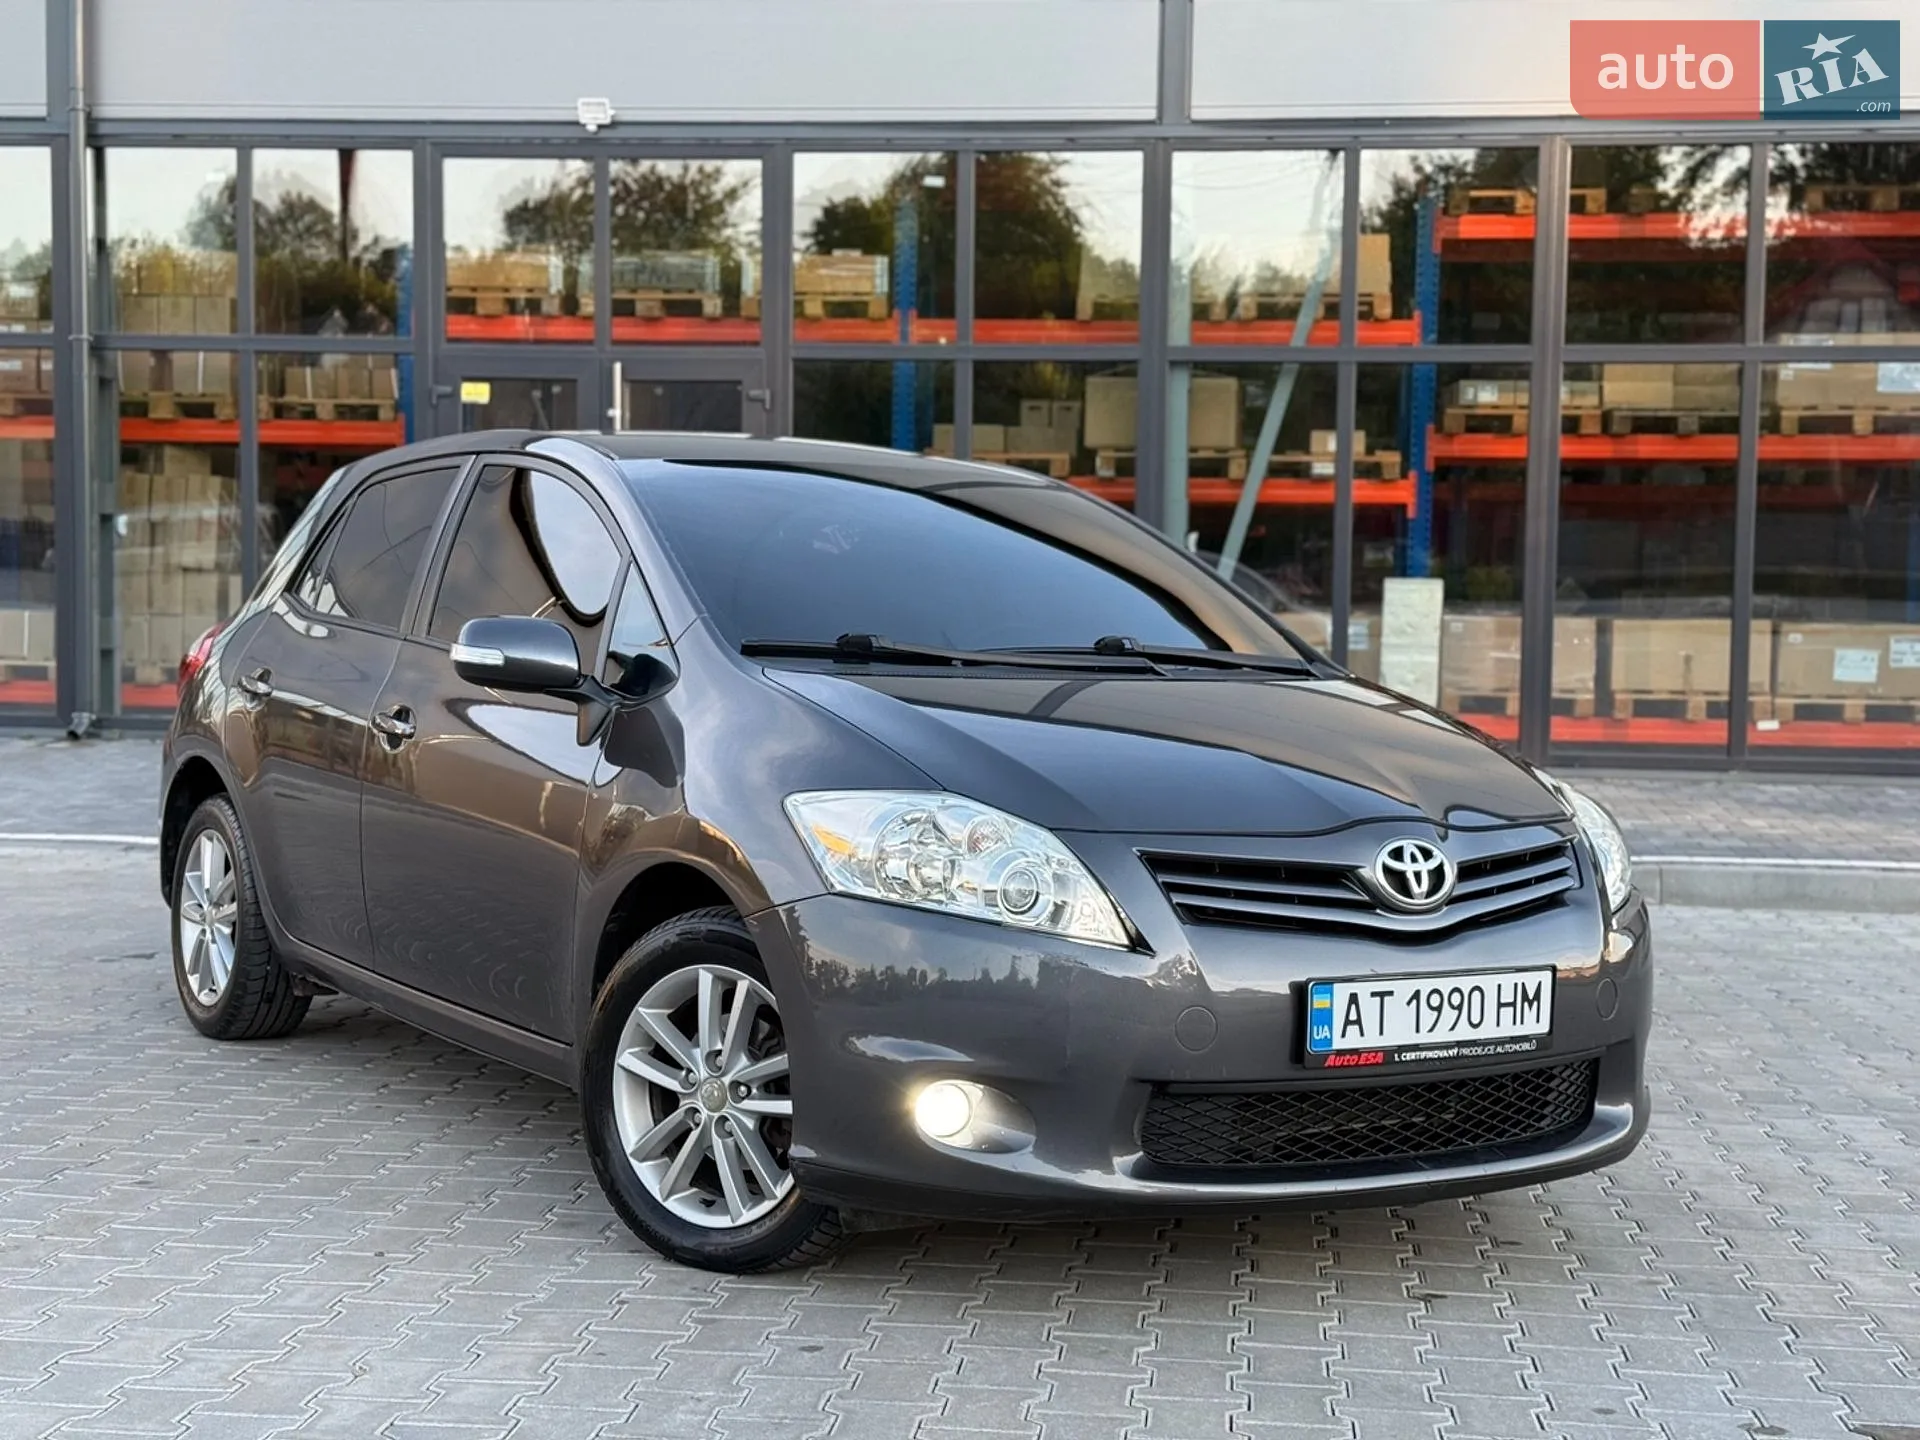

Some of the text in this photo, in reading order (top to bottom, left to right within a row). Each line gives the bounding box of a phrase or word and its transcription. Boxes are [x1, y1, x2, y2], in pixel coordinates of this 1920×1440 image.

[1340, 980, 1542, 1039] AT 1990 HM
[1313, 1025, 1331, 1040] UA
[1358, 1052, 1384, 1065] ESA
